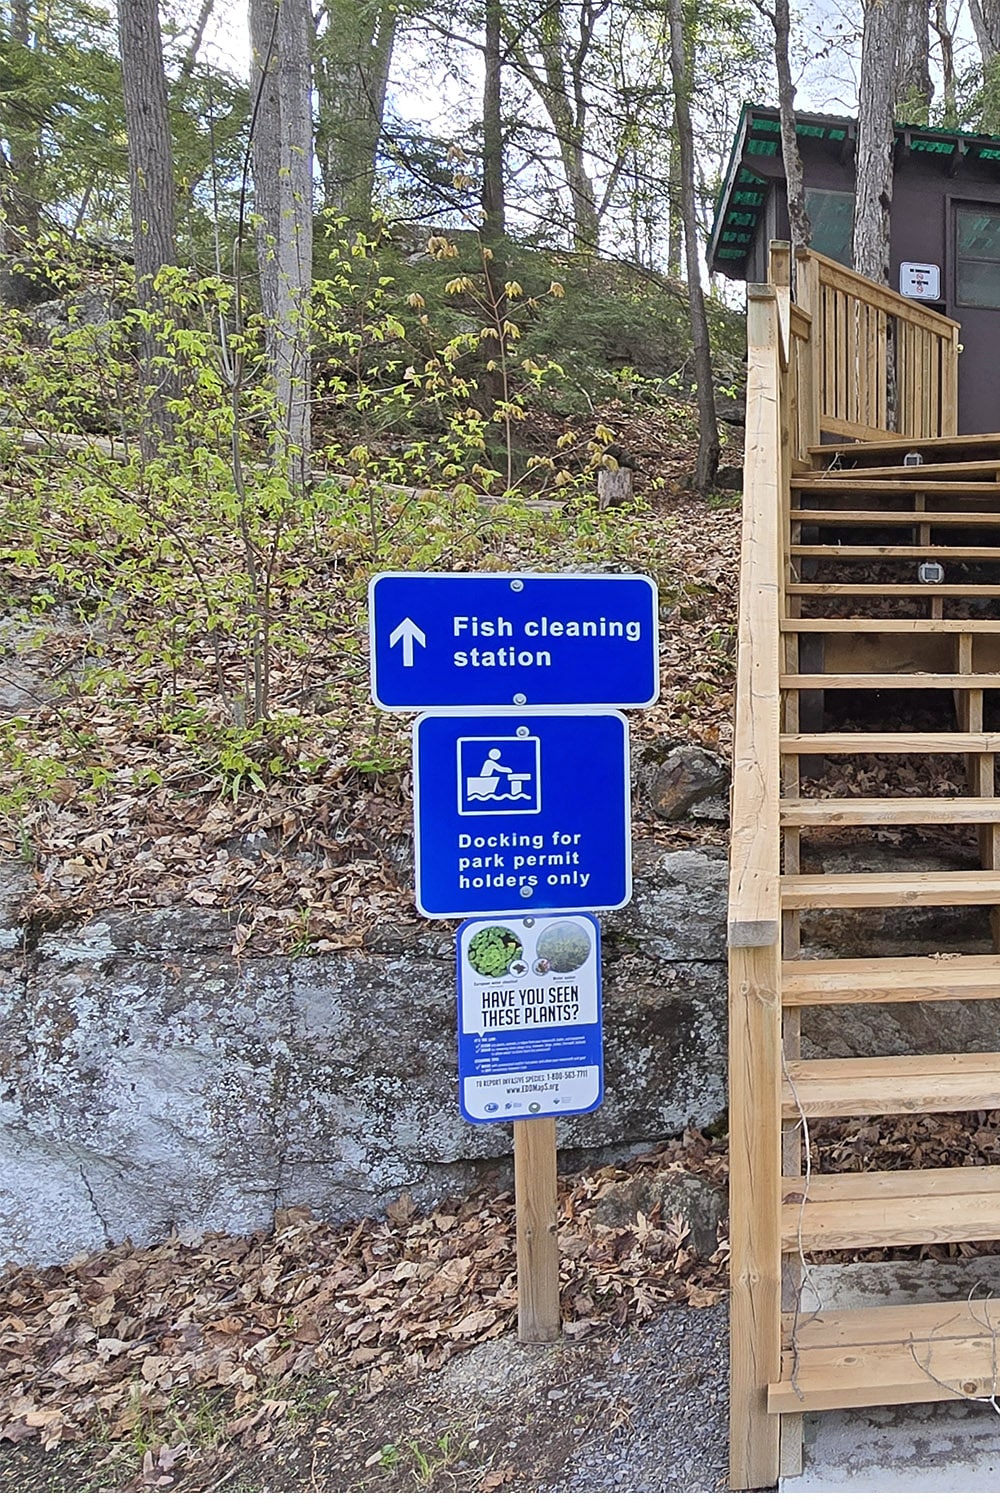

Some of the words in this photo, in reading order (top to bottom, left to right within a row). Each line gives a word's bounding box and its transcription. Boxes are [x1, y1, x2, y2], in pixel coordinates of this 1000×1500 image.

[453, 616, 513, 637] Fish
[524, 616, 641, 642] cleaning
[453, 646, 552, 667] station
[458, 832, 544, 850] Docking
[552, 831, 582, 846] for
[458, 853, 505, 872] park
[513, 851, 580, 870] permit
[459, 873, 539, 889] holders
[547, 870, 591, 888] only
[482, 990, 515, 1009] HAVE
[518, 987, 544, 1006] YOU
[548, 985, 579, 1004] SEEN
[481, 1008, 521, 1027] THESE
[524, 1003, 580, 1024] PLANTS?
